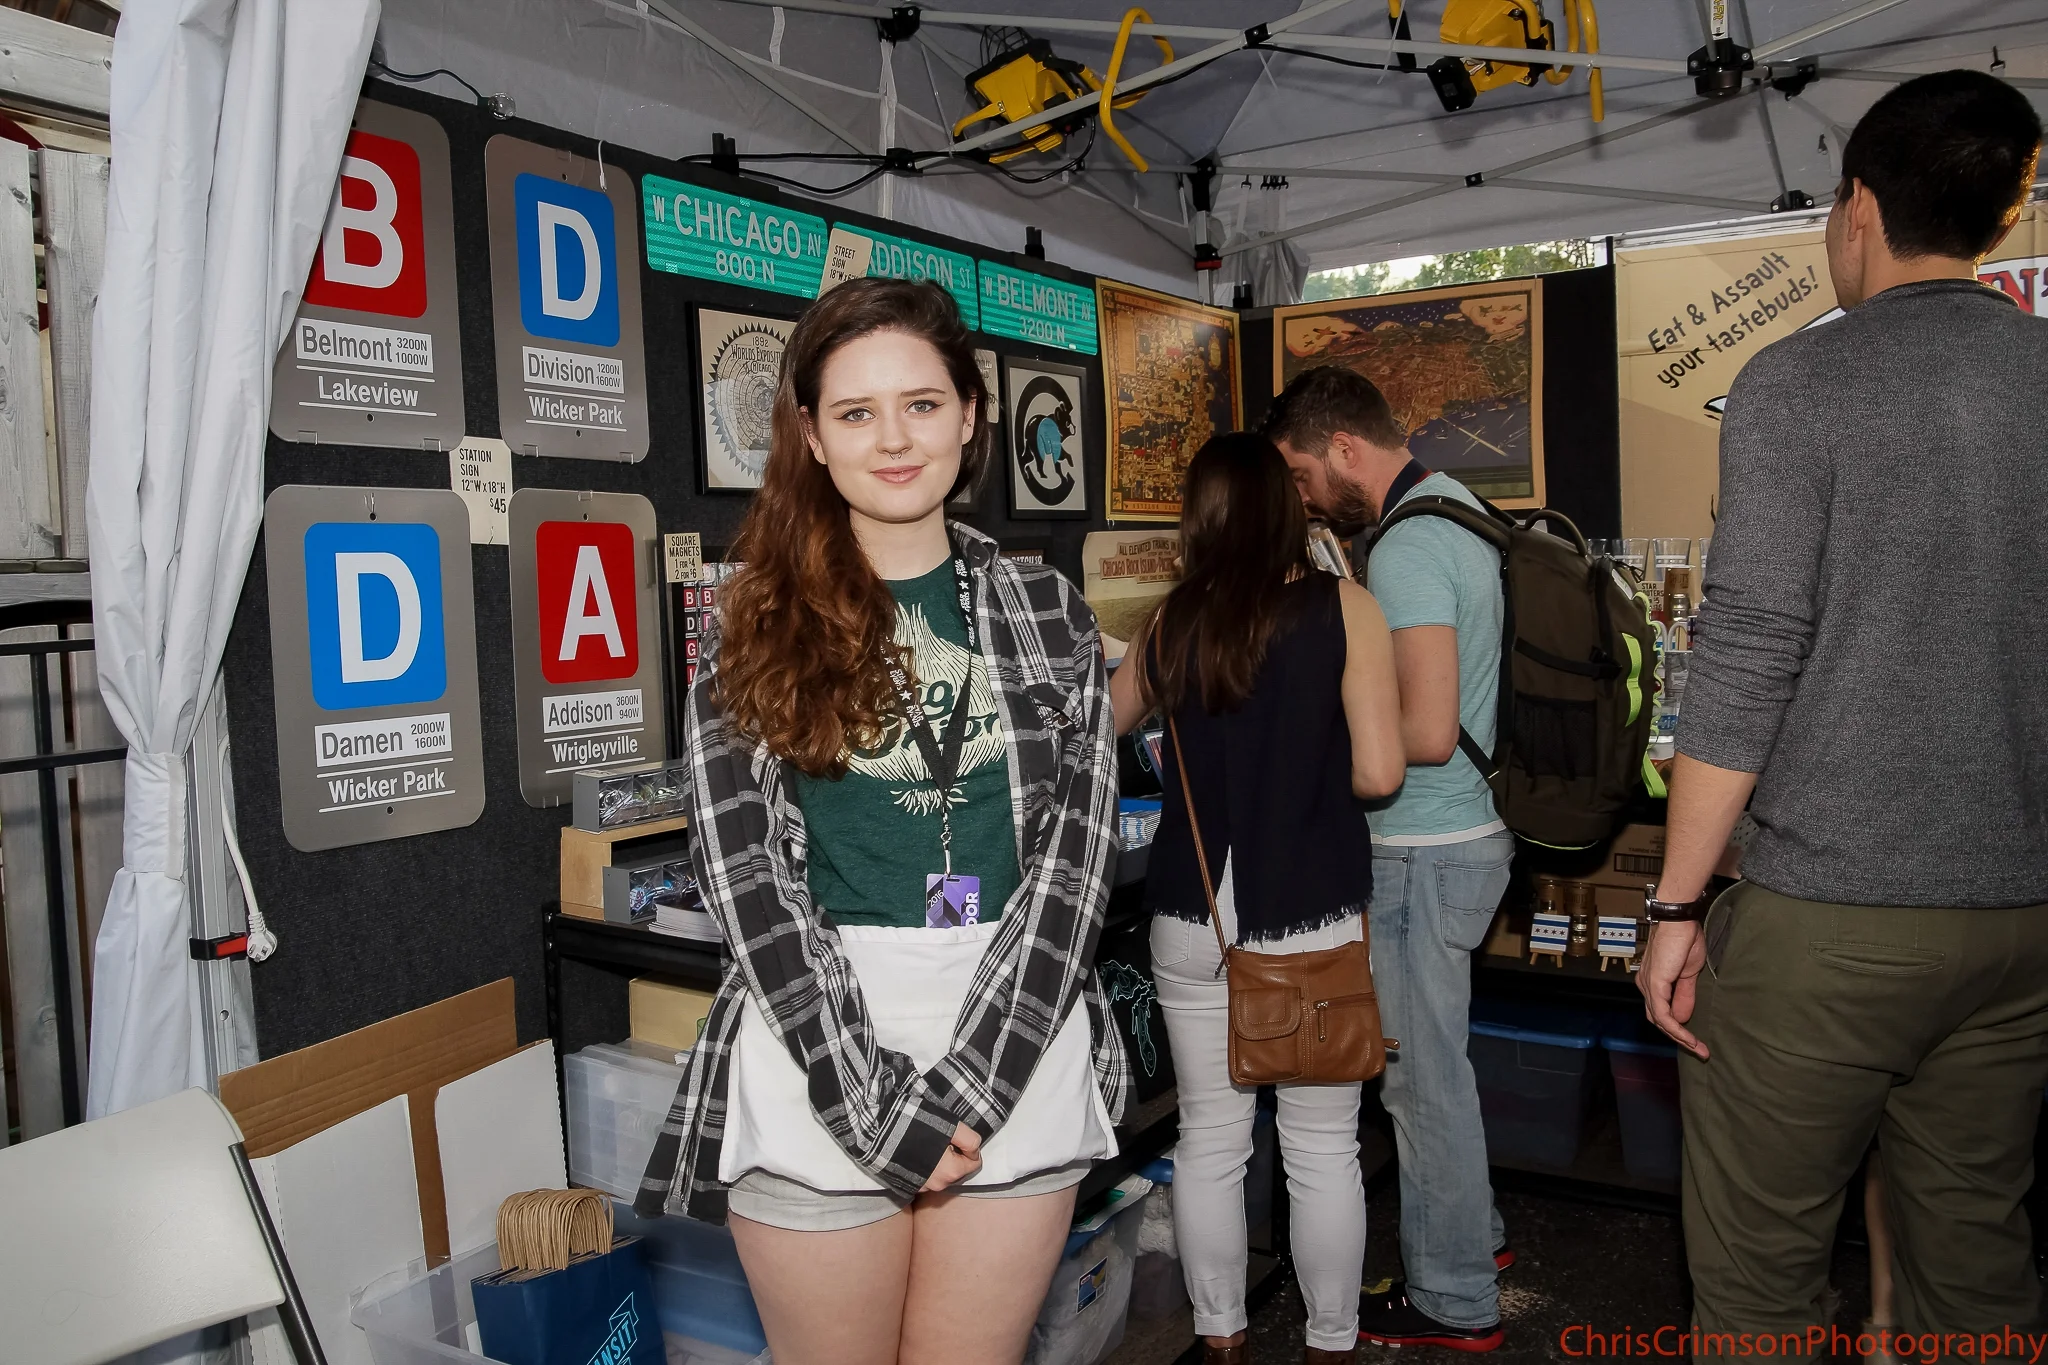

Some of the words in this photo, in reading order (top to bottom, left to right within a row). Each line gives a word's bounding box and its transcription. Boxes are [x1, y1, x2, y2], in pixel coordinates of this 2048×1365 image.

[322, 155, 404, 289] B
[652, 195, 664, 222] W
[674, 194, 801, 259] CHICAGO
[807, 232, 821, 258] AV
[834, 245, 856, 259] STREET
[538, 201, 602, 321] D
[716, 250, 756, 280] 800
[762, 260, 775, 284] N
[832, 257, 846, 269] SIGN
[959, 267, 970, 289] ST
[984, 276, 993, 297] W
[996, 274, 1078, 323] BELMONT
[1082, 302, 1091, 321] AV
[1647, 316, 1686, 354] Eat
[1686, 303, 1708, 326] &
[1710, 252, 1790, 314] Assault
[1019, 316, 1053, 341] 3200
[1056, 326, 1065, 344] N
[1656, 347, 1706, 389] your
[1706, 265, 1819, 352] tastebuds!
[302, 324, 392, 363] Belmont
[396, 336, 428, 352] 3200N
[752, 336, 768, 347] 1892
[395, 352, 428, 366] 1000W
[528, 353, 595, 385] Division
[596, 363, 620, 375] 1200N
[596, 376, 620, 388] 1600W
[318, 376, 419, 407] Lakeview
[528, 396, 585, 422] Wicker
[589, 400, 623, 425] Park
[460, 448, 492, 462] STATION
[460, 464, 479, 476] SIGN
[490, 498, 506, 513] $45
[671, 536, 696, 547] SQUARE
[669, 546, 700, 558] MAGNETS
[675, 559, 678, 569] 1
[680, 561, 688, 569] FOR
[688, 558, 696, 568] $4
[1103, 560, 1125, 577] CHICAGO
[1126, 559, 1140, 575] ROCK
[675, 570, 680, 580] 2
[681, 571, 689, 579] FOR
[690, 569, 696, 579] $6
[558, 545, 626, 661] A
[686, 592, 694, 605] B
[704, 591, 712, 604] B
[335, 552, 422, 684] D
[687, 617, 695, 631] D
[687, 642, 695, 656] G
[616, 695, 639, 707] 3600N
[548, 700, 613, 728] Addison
[619, 708, 640, 720] 940W
[410, 720, 445, 735] 2000W
[321, 728, 403, 760] Damen
[414, 735, 446, 749] 1600N
[552, 736, 638, 766] Wrigleyville
[328, 774, 398, 803] Wicker
[403, 767, 446, 793] Park
[928, 890, 944, 908] 2016
